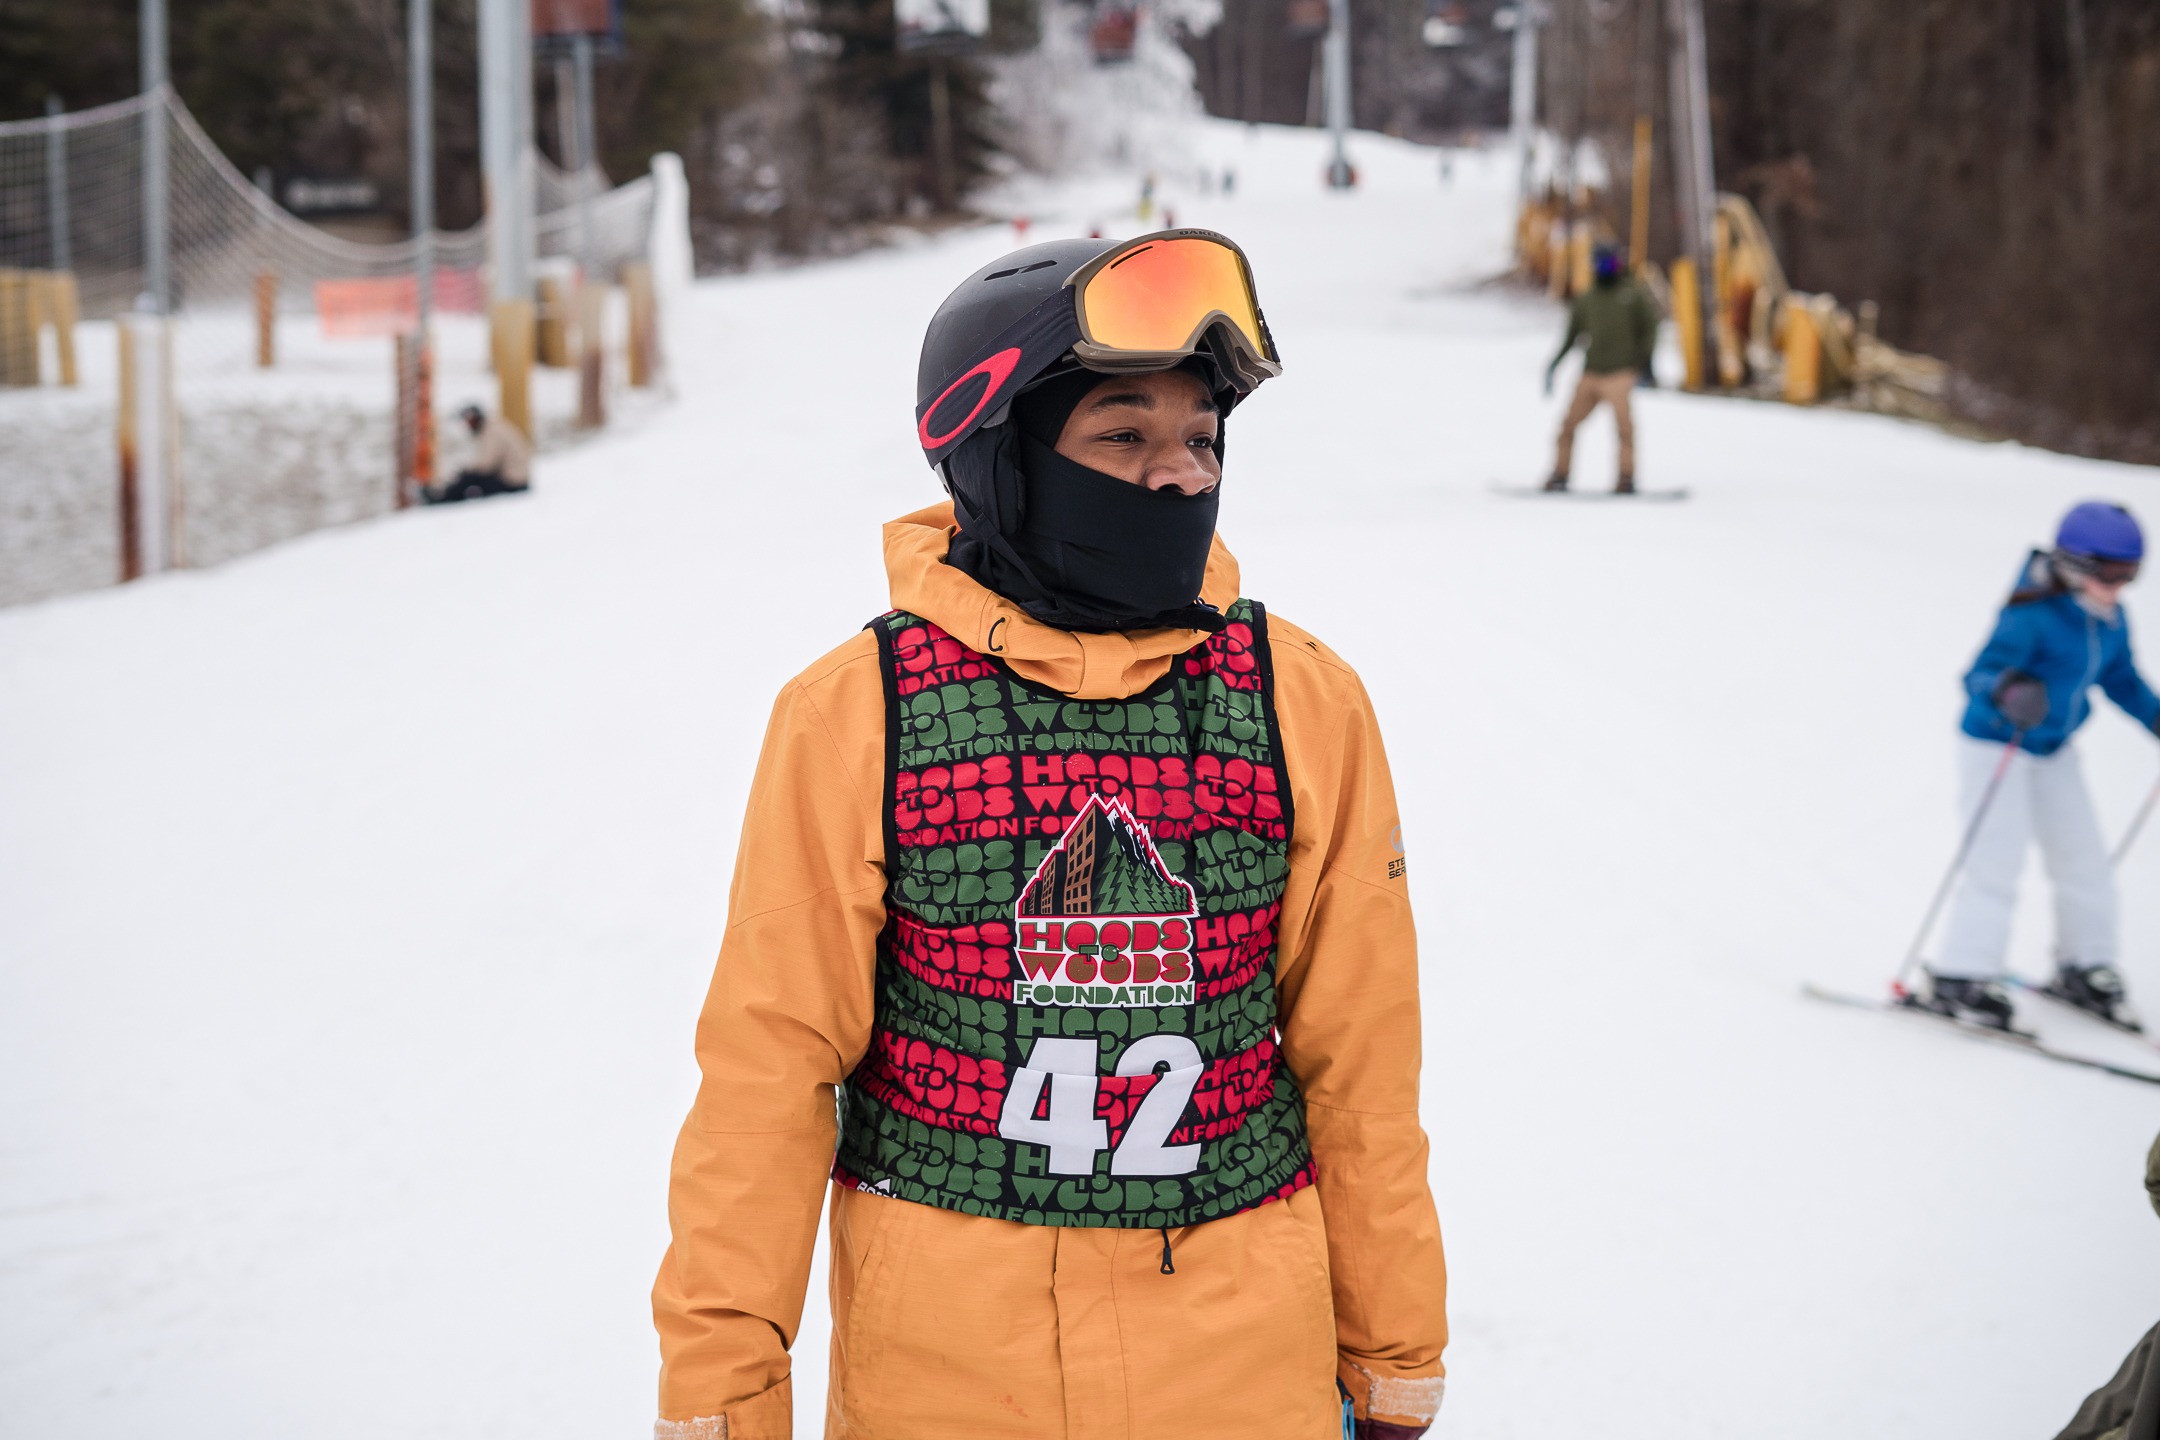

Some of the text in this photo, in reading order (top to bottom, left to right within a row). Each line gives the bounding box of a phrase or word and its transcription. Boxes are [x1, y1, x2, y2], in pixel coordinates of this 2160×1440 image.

[1012, 703, 1181, 734] WOODS
[1018, 732, 1188, 754] FOUNDATION
[1022, 754, 1190, 787] HOODS
[1019, 918, 1190, 952] HOODS
[1018, 951, 1191, 984] WOODS
[1079, 944, 1119, 962] TO
[1016, 983, 1193, 1005] FOUNDATION
[1017, 1006, 1187, 1039] HOODS
[884, 1031, 1007, 1090] HOODS
[998, 1035, 1204, 1175] 42
[880, 1110, 1007, 1168] HOODS
[1011, 1175, 1185, 1212] WOODS
[1006, 1206, 1186, 1228] FOUNDATION
